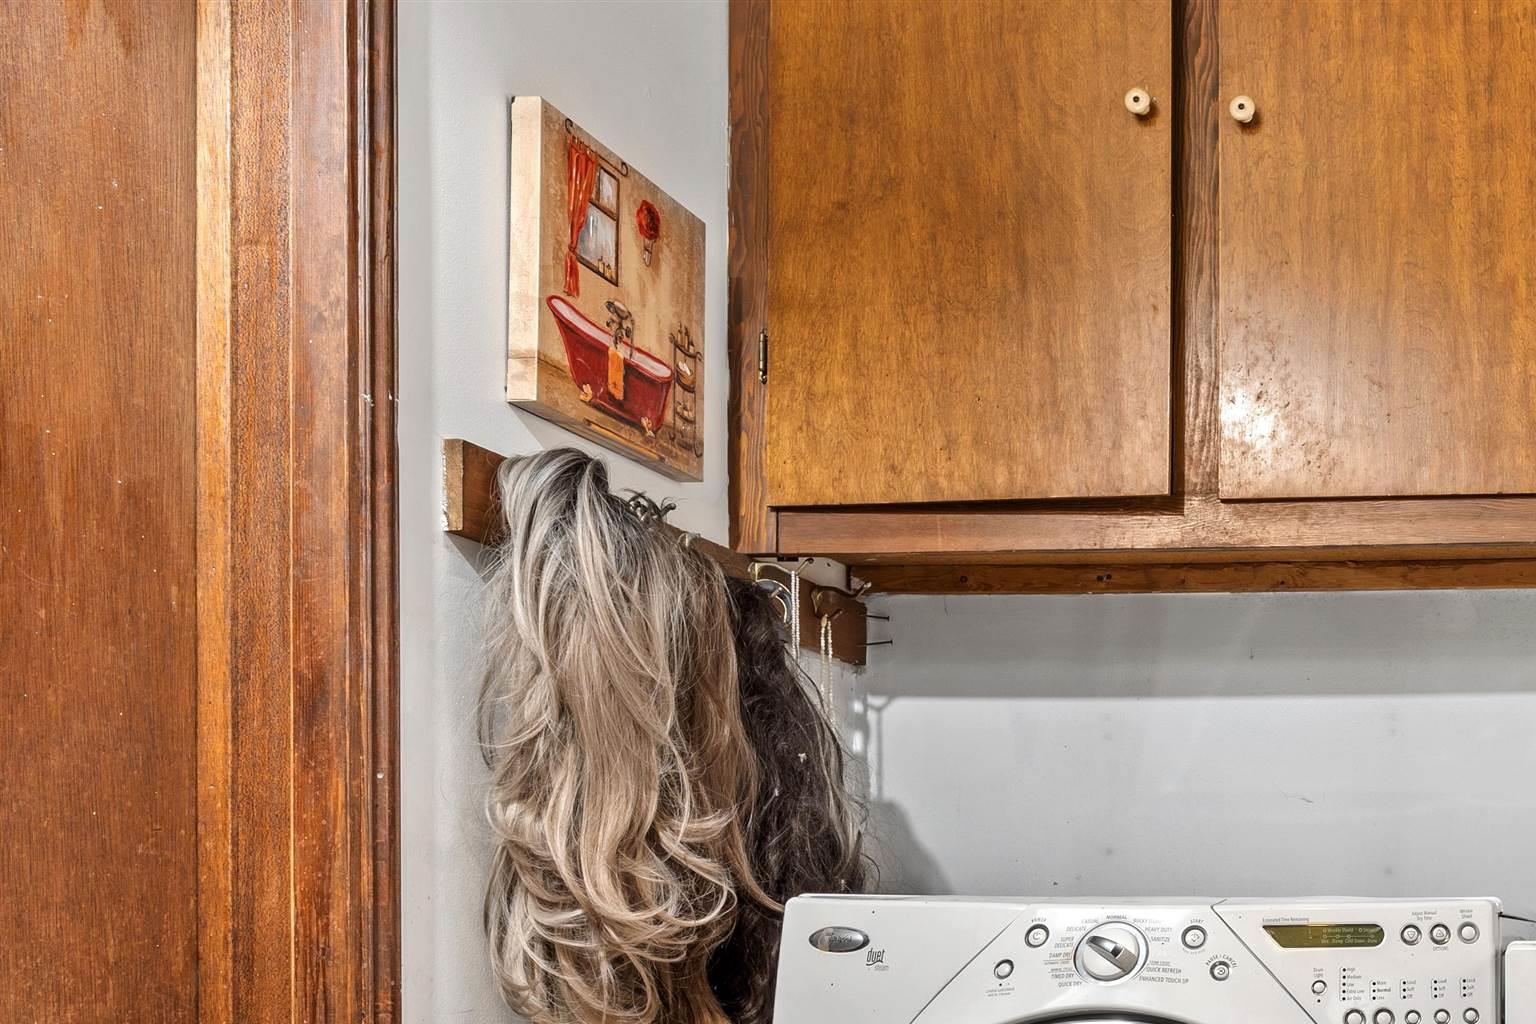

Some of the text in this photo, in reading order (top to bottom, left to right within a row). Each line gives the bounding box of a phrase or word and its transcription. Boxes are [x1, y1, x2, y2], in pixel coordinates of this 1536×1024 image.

[867, 948, 885, 962] duet
[1205, 954, 1218, 966] PAUSE
[1222, 954, 1237, 968] CANCEL
